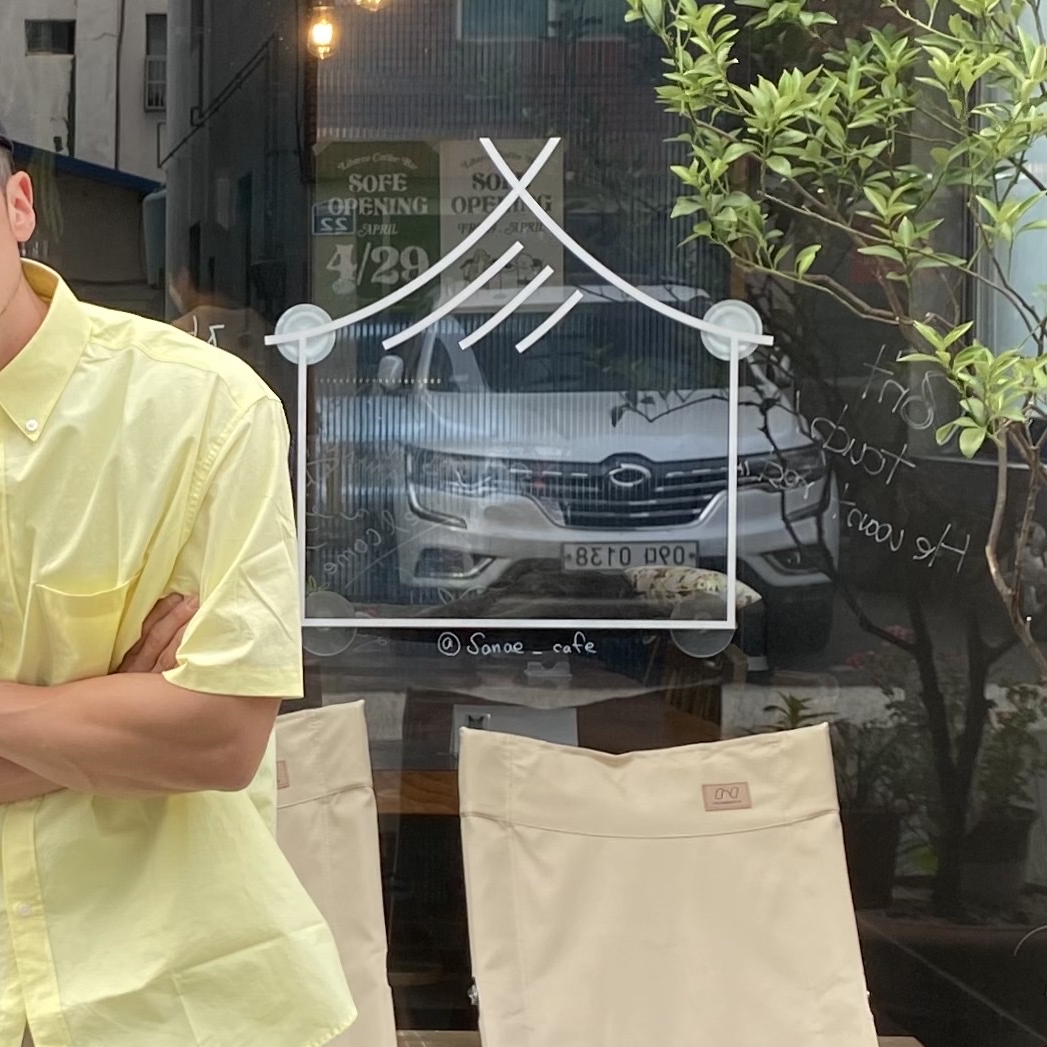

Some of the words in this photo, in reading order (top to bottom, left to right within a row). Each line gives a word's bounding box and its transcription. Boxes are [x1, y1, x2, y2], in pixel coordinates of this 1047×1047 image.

[327, 196, 429, 216] OPENING
[357, 223, 400, 237] APRIL
[326, 242, 432, 287] 4/29
